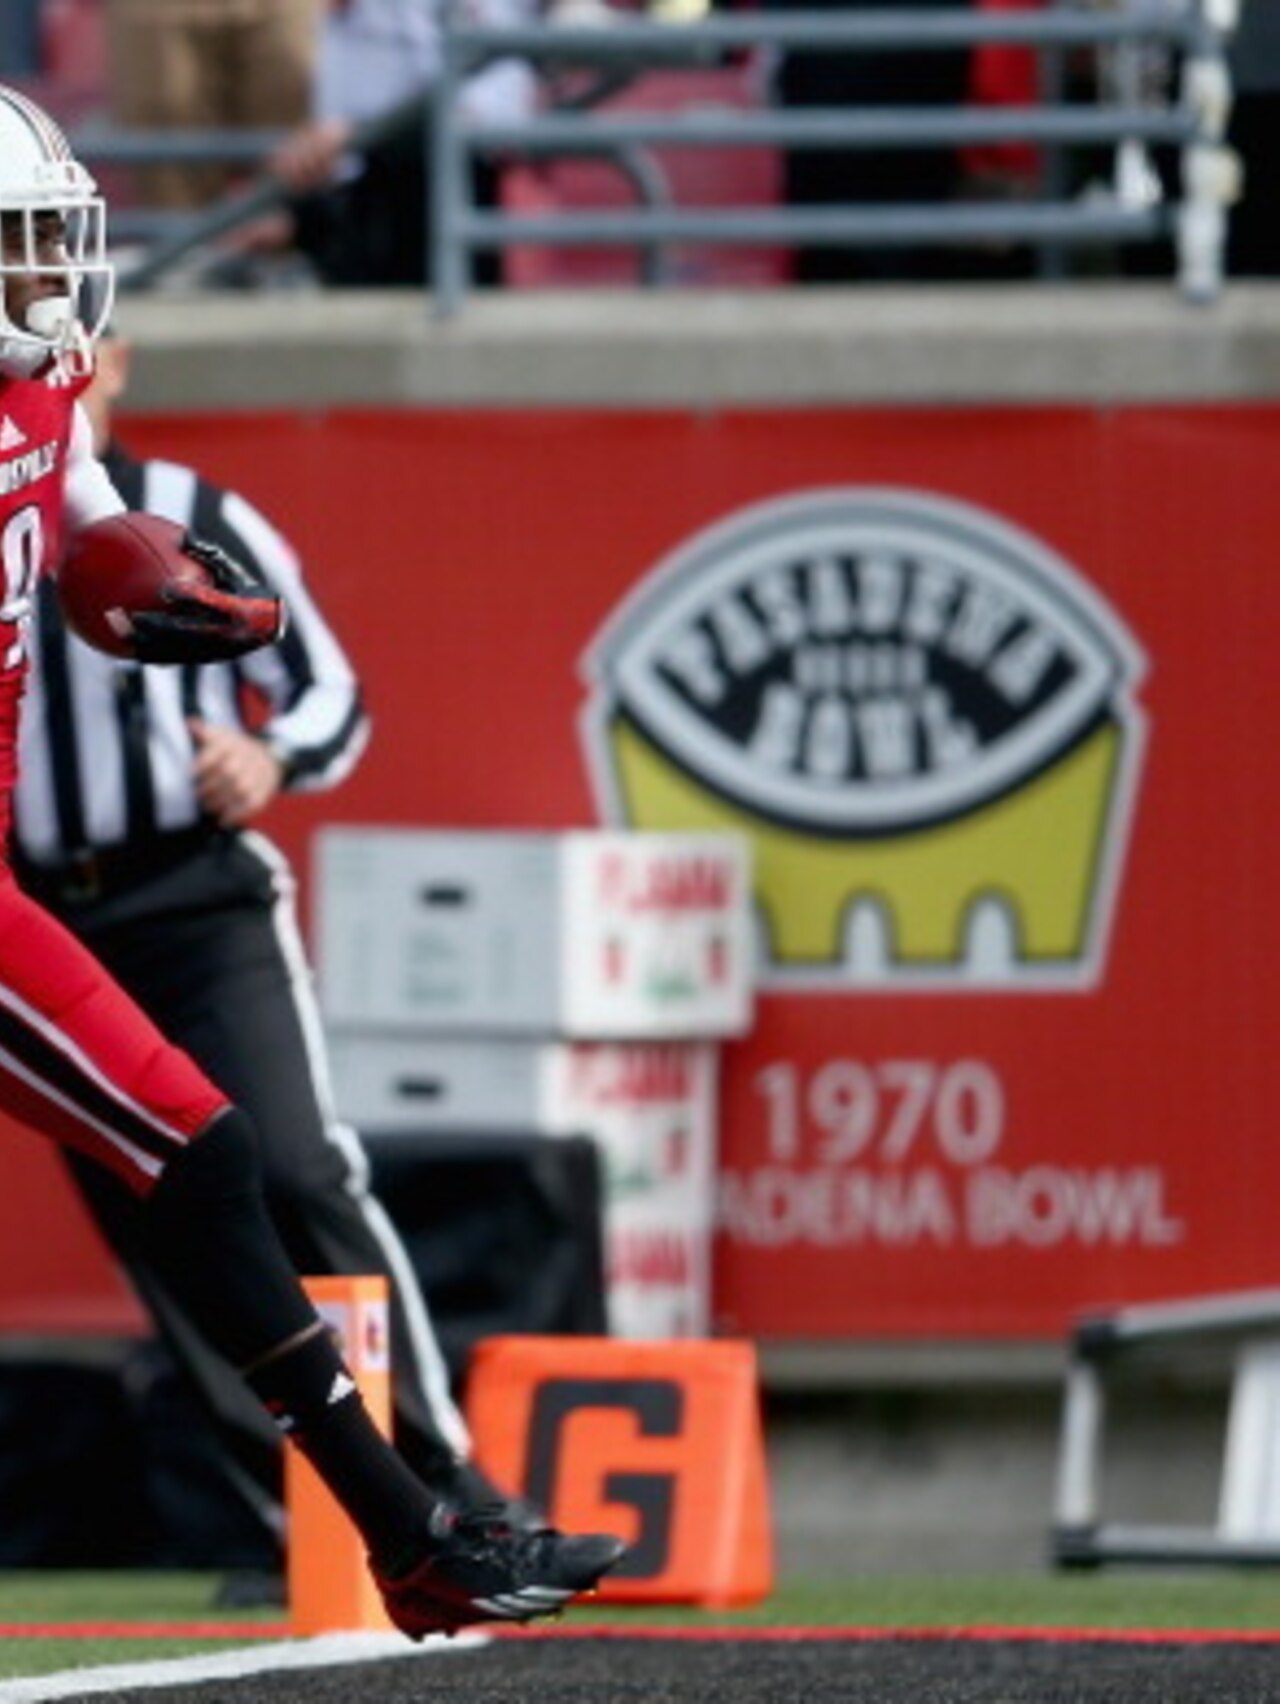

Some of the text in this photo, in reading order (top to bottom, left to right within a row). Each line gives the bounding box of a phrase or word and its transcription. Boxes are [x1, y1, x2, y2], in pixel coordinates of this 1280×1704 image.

[658, 554, 1060, 706] PASADENA
[747, 684, 980, 782] BOWL
[754, 1058, 1006, 1164] 1970
[718, 1166, 1186, 1246] ADENA BOWL
[522, 1378, 686, 1578] G
